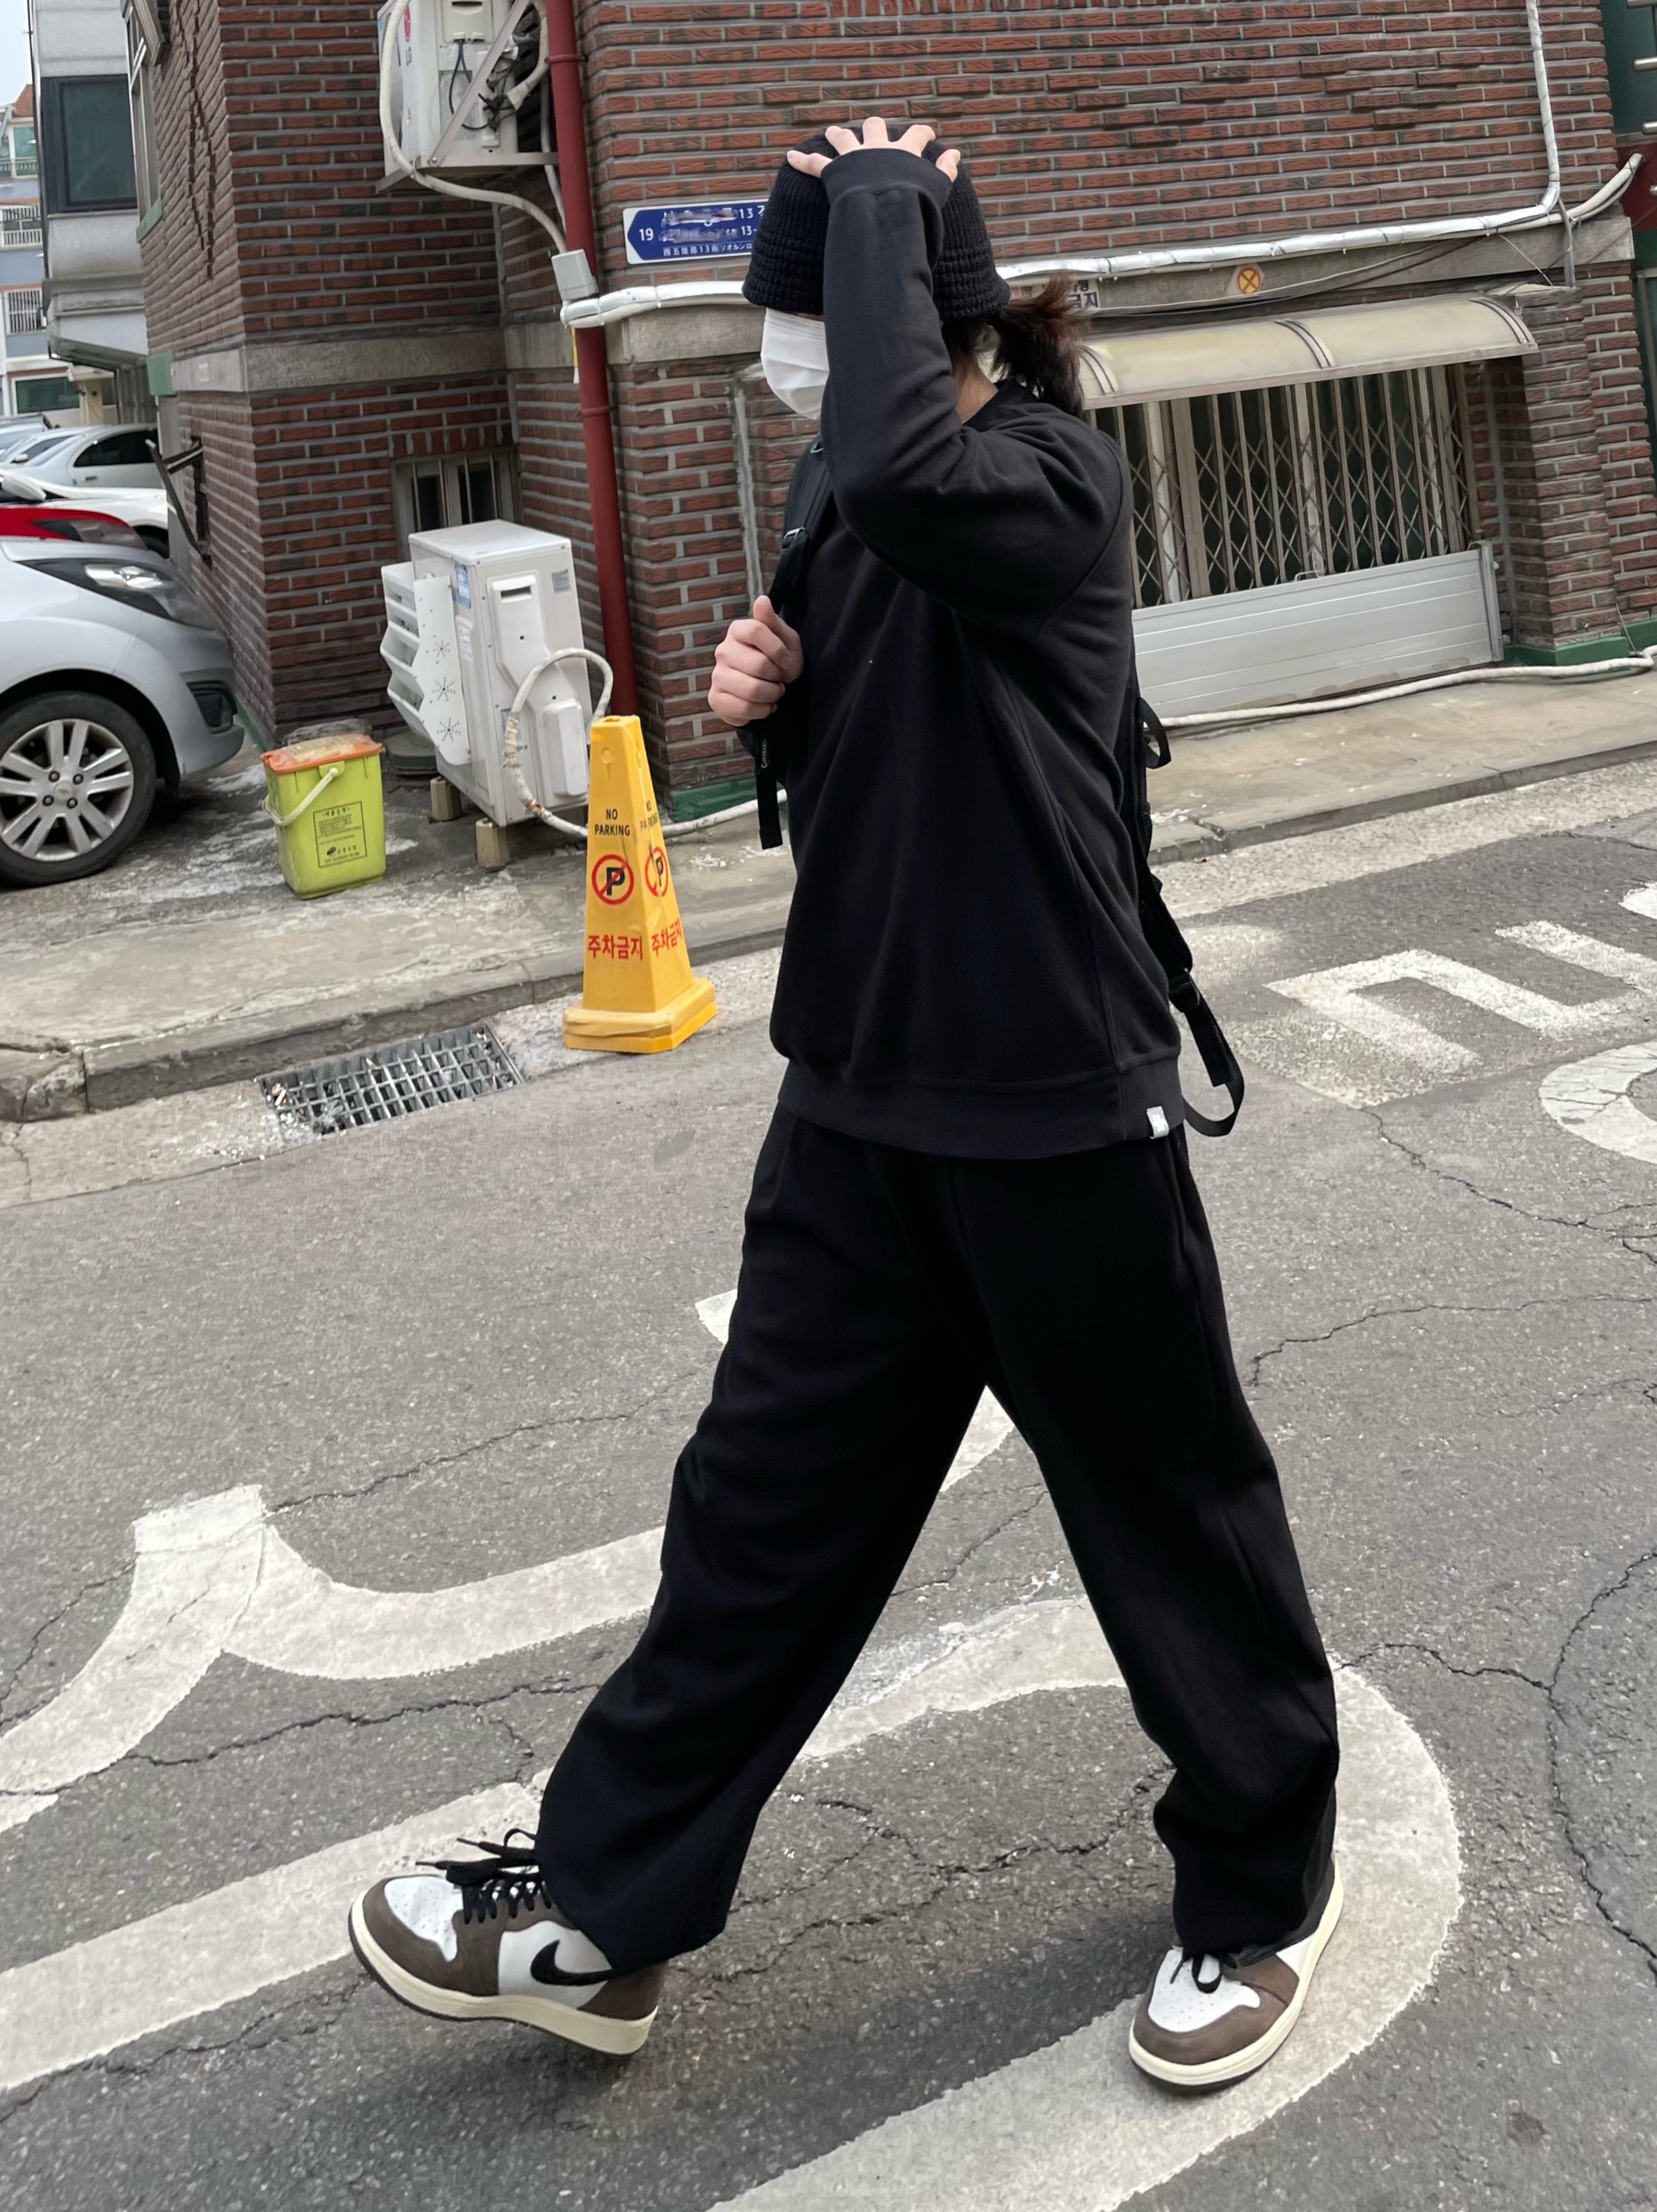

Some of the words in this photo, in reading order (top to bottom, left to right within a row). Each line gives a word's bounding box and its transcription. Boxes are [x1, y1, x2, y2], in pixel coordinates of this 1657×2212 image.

[639, 228, 654, 241] 19
[741, 226, 757, 236] 13-
[606, 808, 618, 821] NO
[595, 823, 631, 836] PARKING
[606, 867, 625, 896] P
[651, 917, 683, 957] 주차금지
[588, 934, 643, 961] 주차금지
